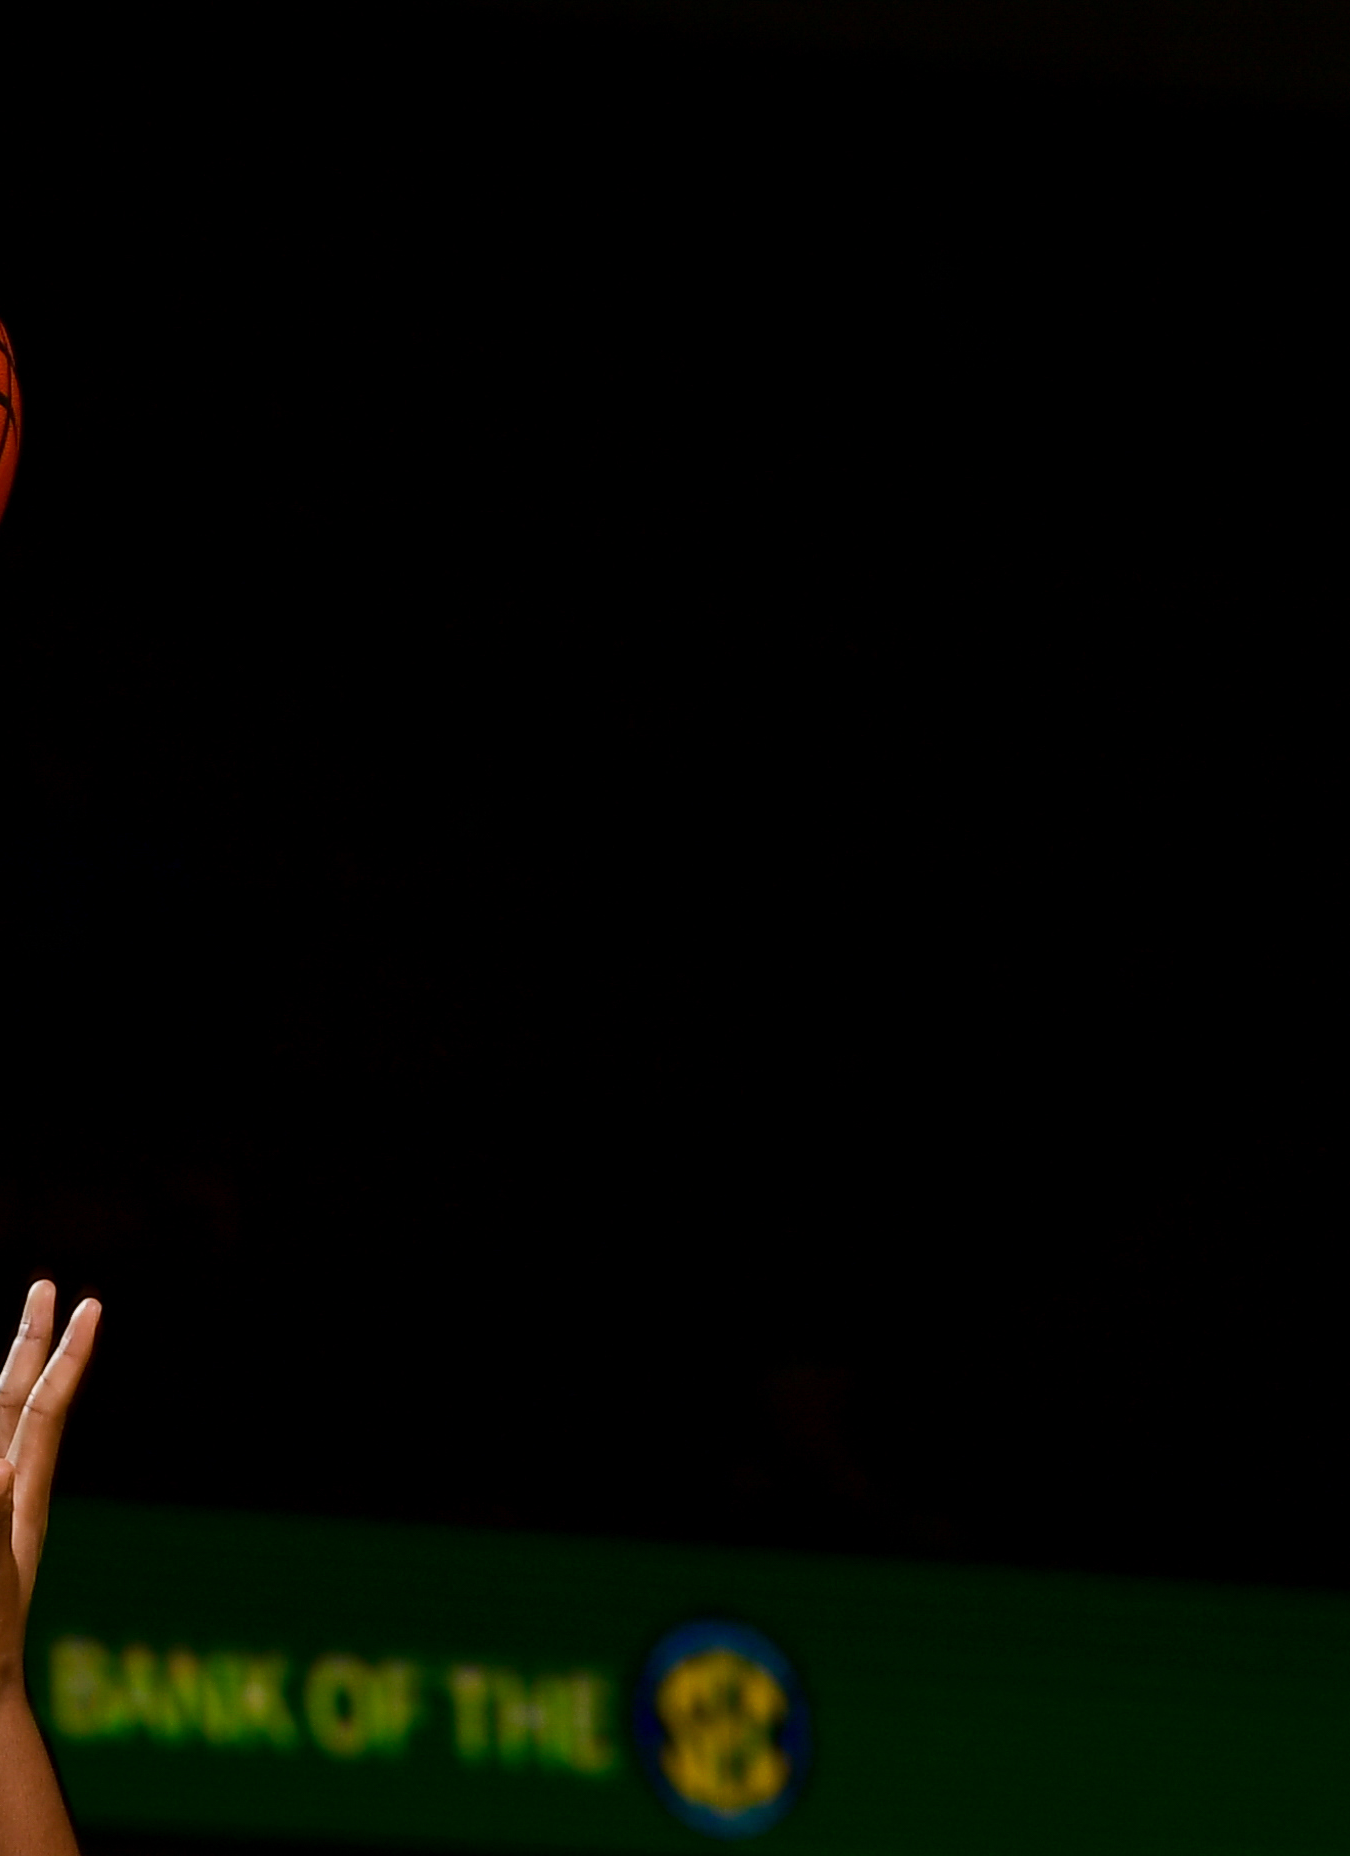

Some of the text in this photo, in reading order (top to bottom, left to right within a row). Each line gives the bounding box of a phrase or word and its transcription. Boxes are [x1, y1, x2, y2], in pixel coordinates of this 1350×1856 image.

[49, 1636, 295, 1748] BANK
[305, 1652, 425, 1758] OF
[449, 1664, 613, 1775] THE
